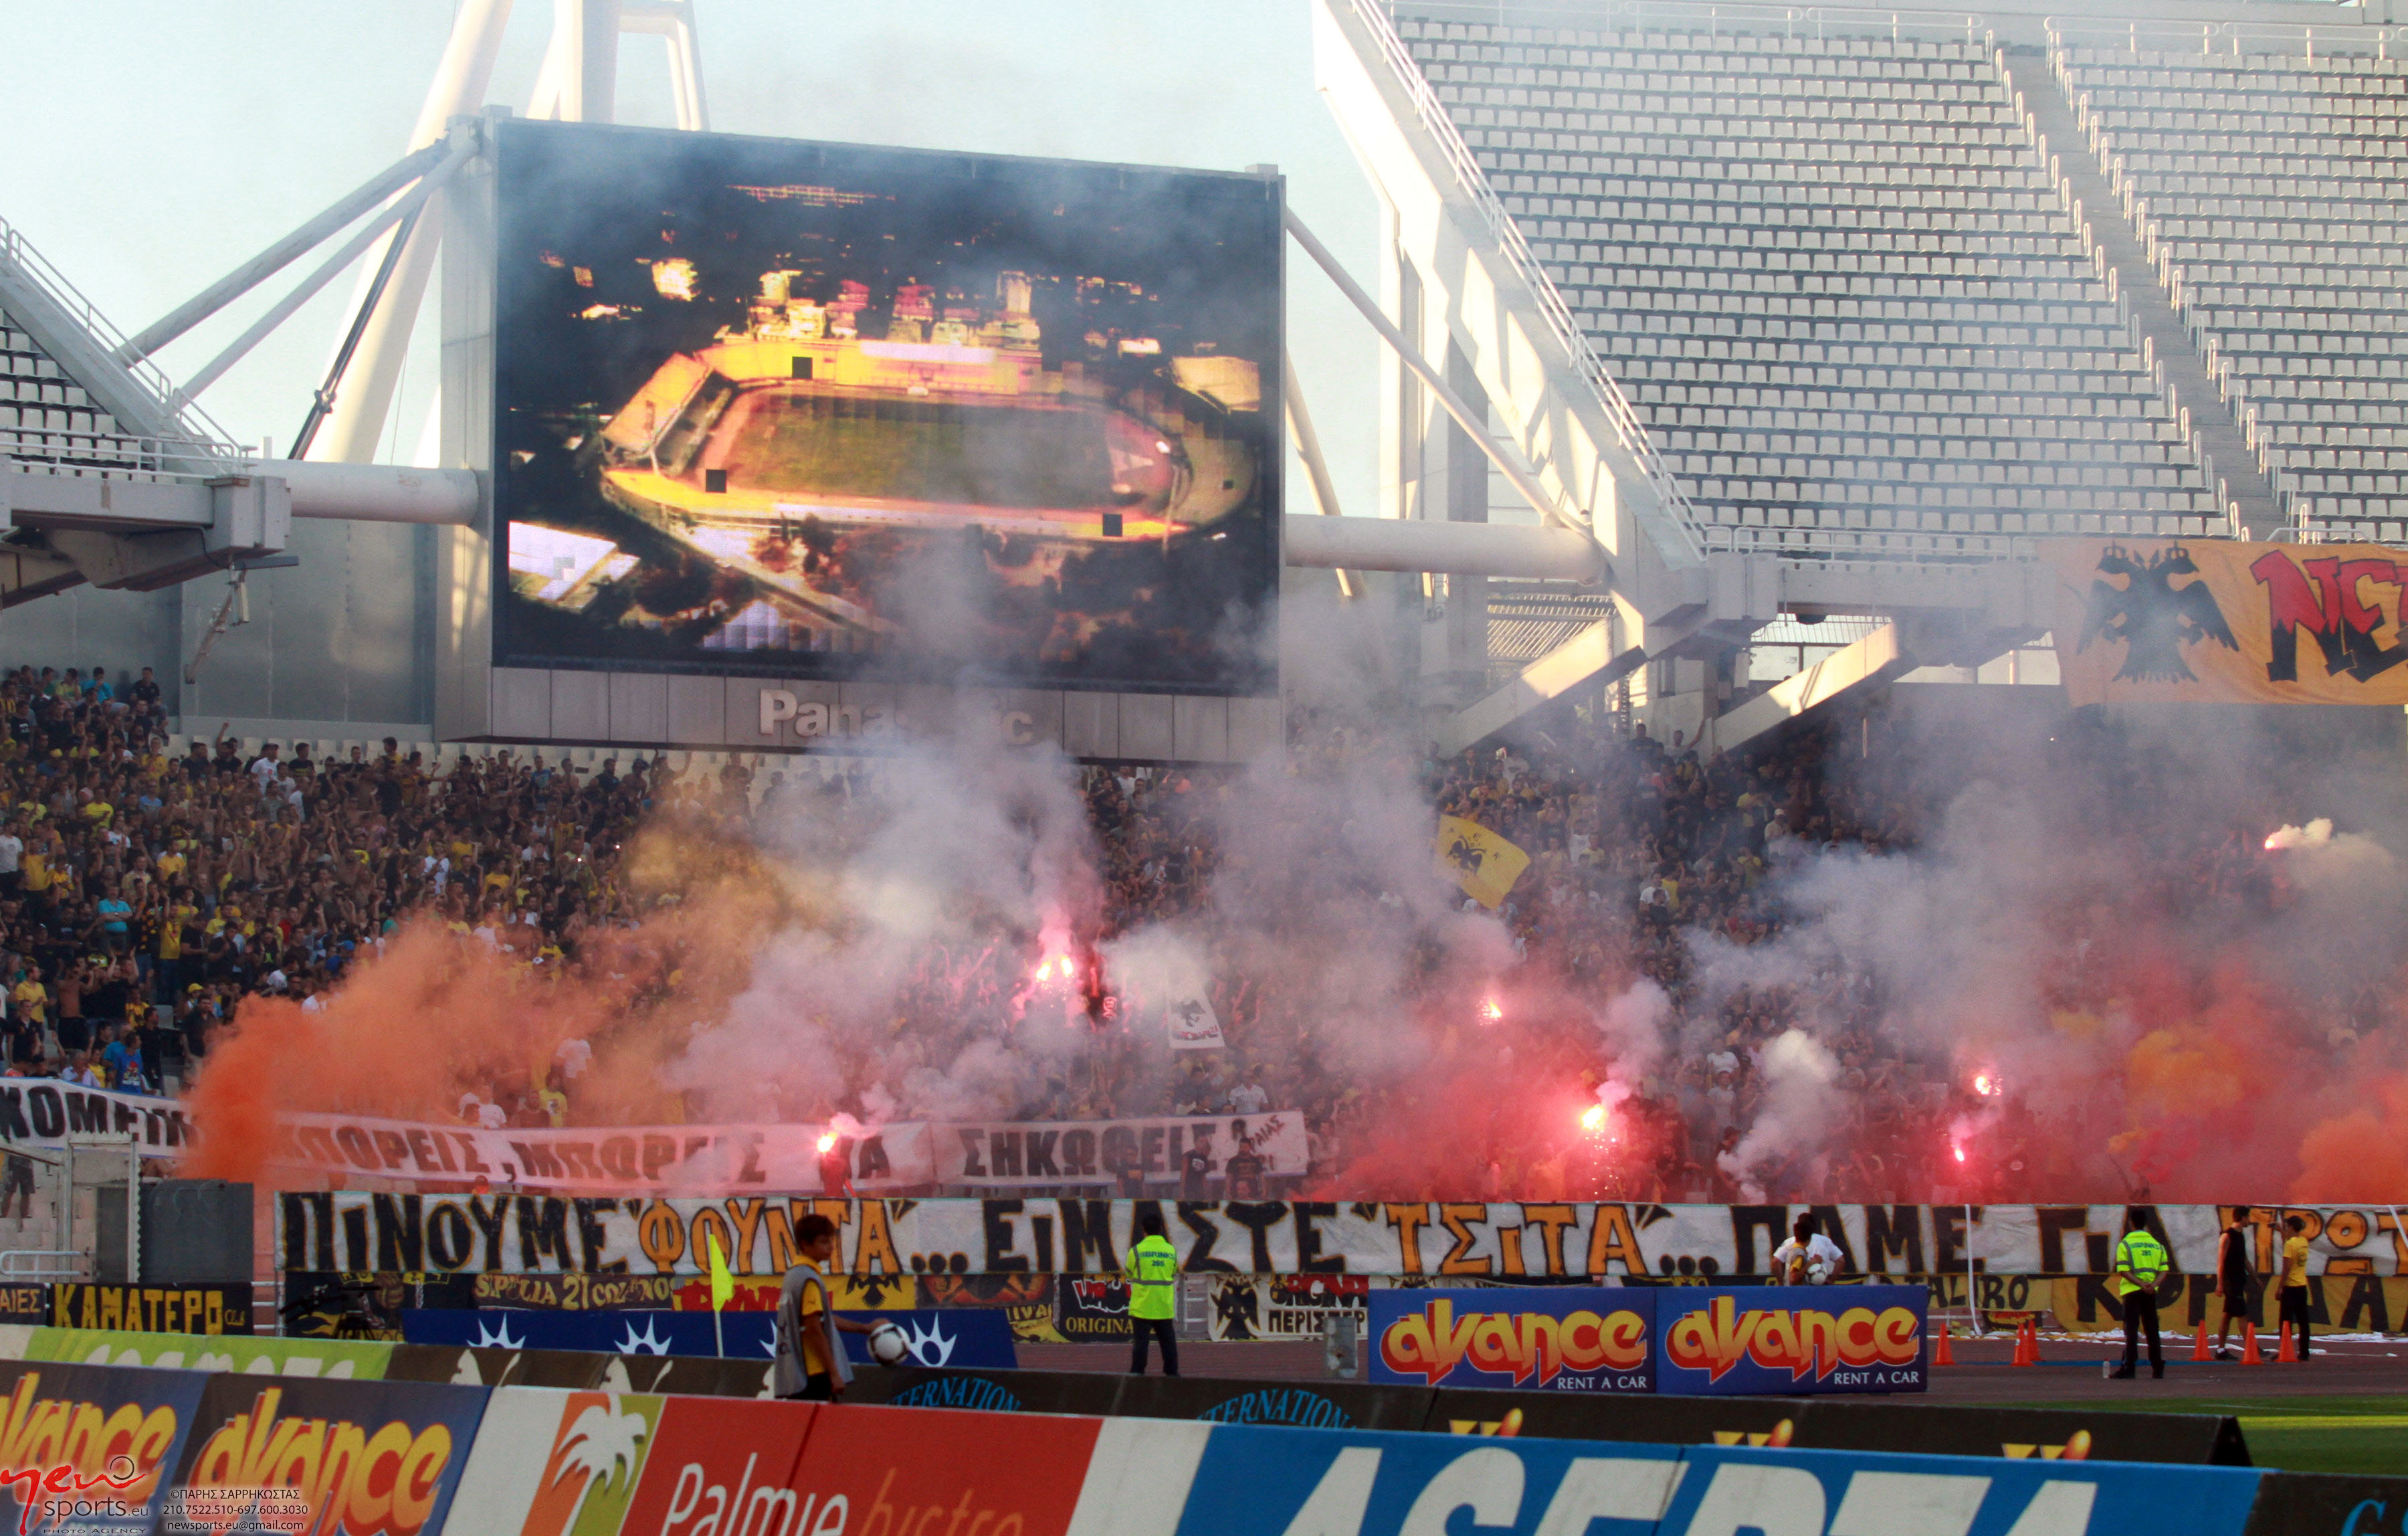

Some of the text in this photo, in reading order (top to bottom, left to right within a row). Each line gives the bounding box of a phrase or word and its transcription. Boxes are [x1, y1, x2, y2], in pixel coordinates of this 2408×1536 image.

[562, 1275, 591, 1311] 21
[1066, 1316, 1135, 1334] ORIGINA
[1557, 1375, 1647, 1389] RENT A CAR
[1834, 1371, 1919, 1385] RENT A CAR
